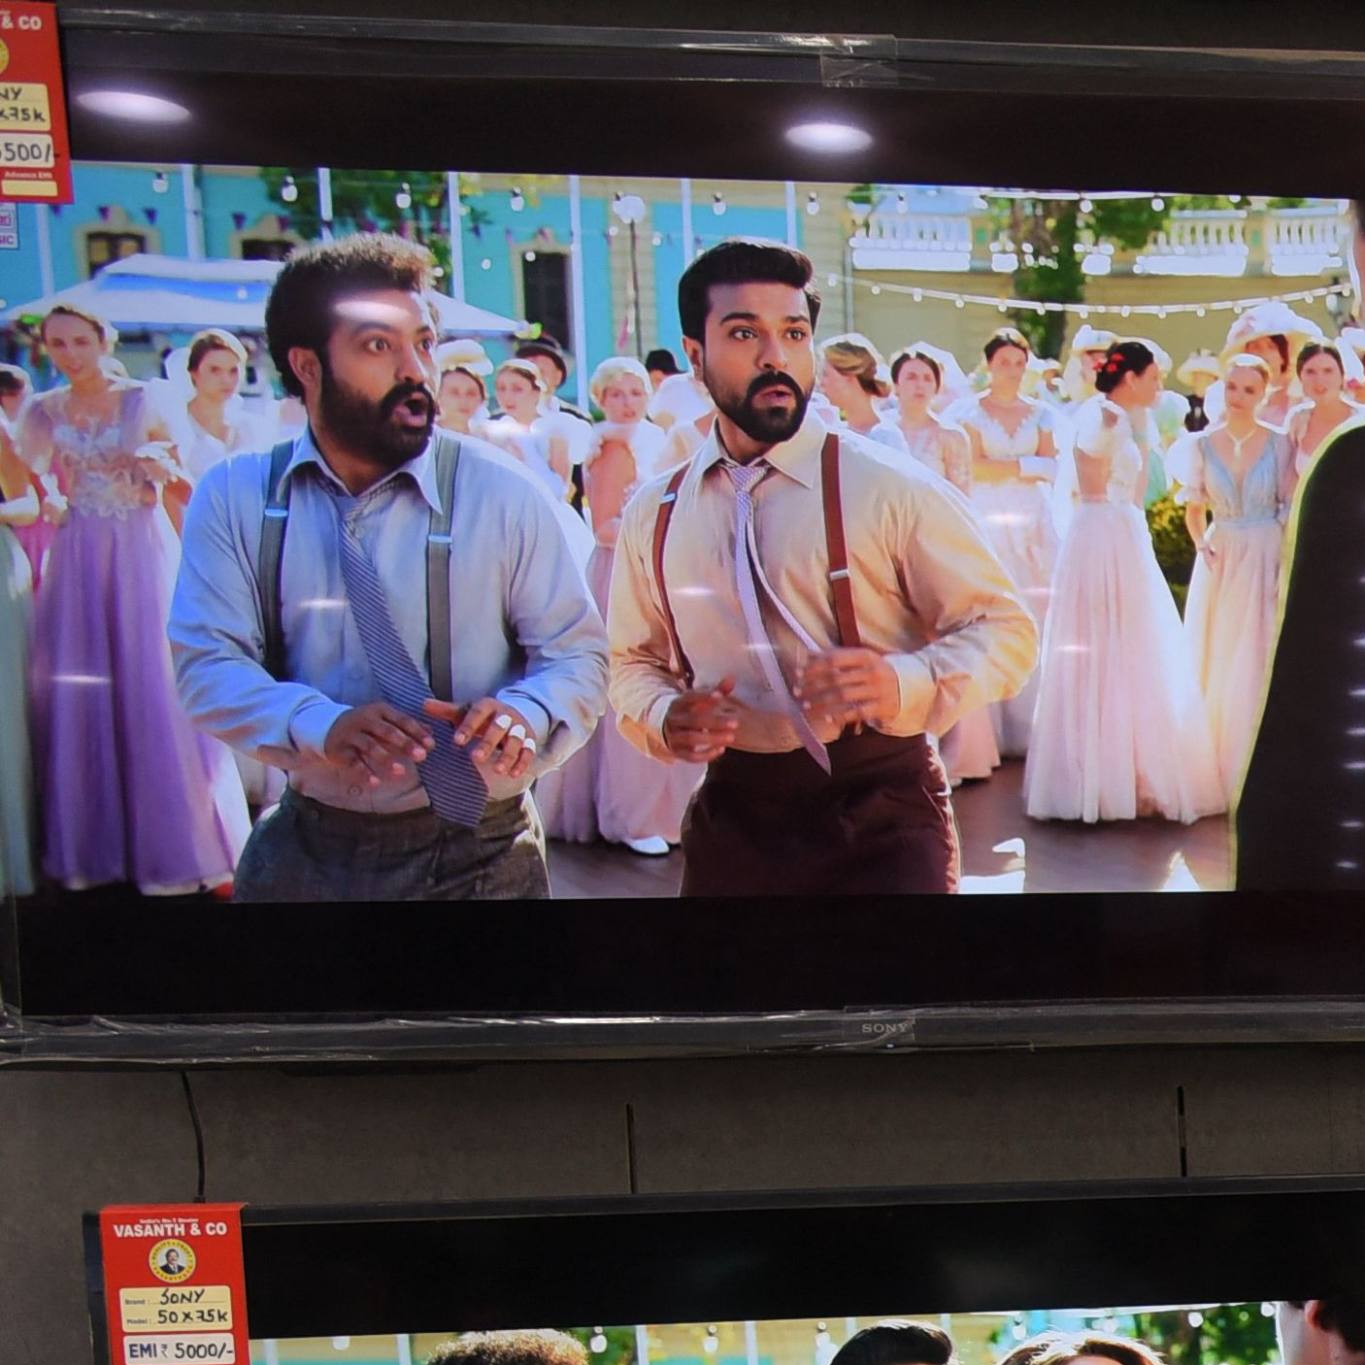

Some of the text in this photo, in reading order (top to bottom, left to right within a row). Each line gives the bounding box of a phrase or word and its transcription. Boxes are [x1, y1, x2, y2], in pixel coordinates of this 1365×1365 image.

[18, 16, 42, 30] CO
[862, 1023, 908, 1033] SONY
[112, 1222, 227, 1237] VASANTH & CO
[160, 1288, 205, 1305] SONY
[128, 1343, 157, 1358] EMI
